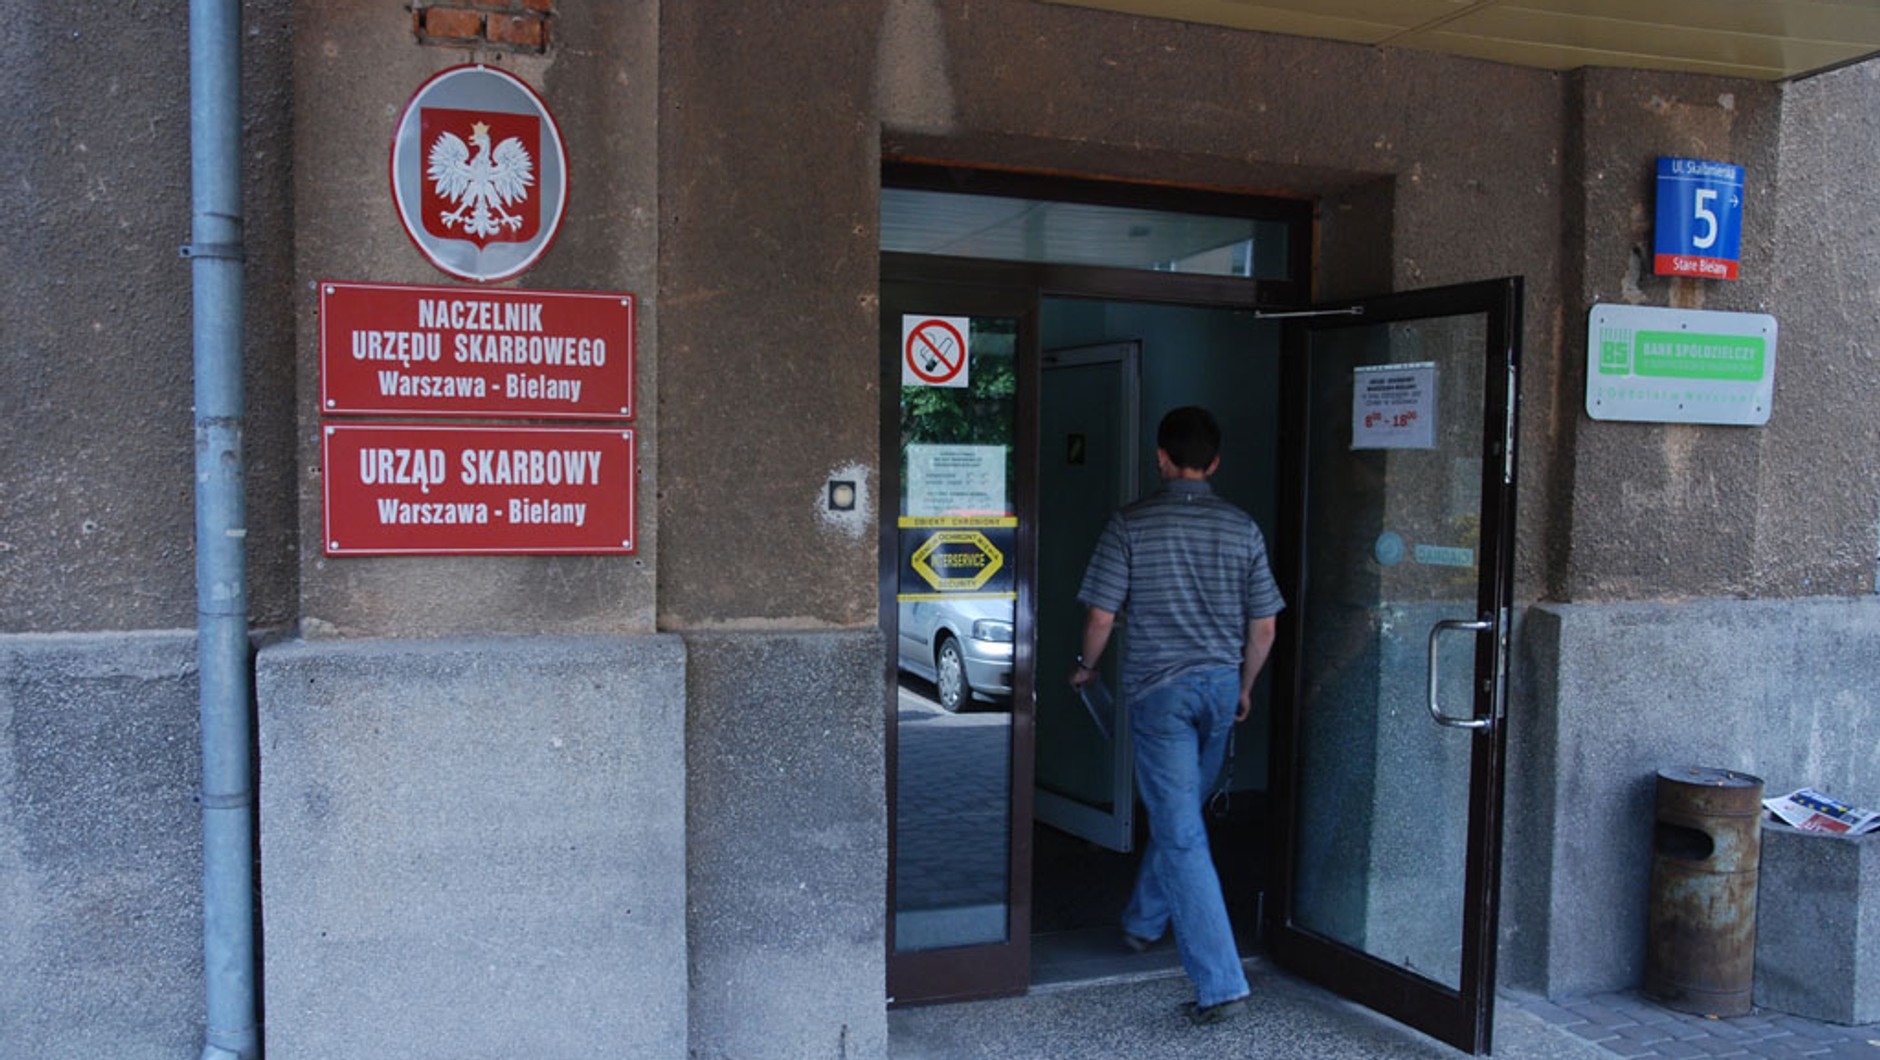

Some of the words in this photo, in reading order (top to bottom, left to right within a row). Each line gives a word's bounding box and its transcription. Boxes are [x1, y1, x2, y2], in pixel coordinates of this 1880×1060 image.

[1692, 188, 1718, 249] 5
[1672, 257, 1697, 272] Stare
[1700, 259, 1728, 279] Bielany
[418, 299, 543, 331] NACZELNIK
[352, 330, 441, 368] URZĘDU
[454, 333, 606, 367] SKARBOWEGO
[378, 370, 486, 398] Warszawa
[506, 373, 582, 402] Bielany
[359, 448, 446, 494] URZĄD
[461, 449, 602, 485] SKARBOWY
[377, 498, 488, 524] Warszawa
[508, 498, 587, 527] Bielany
